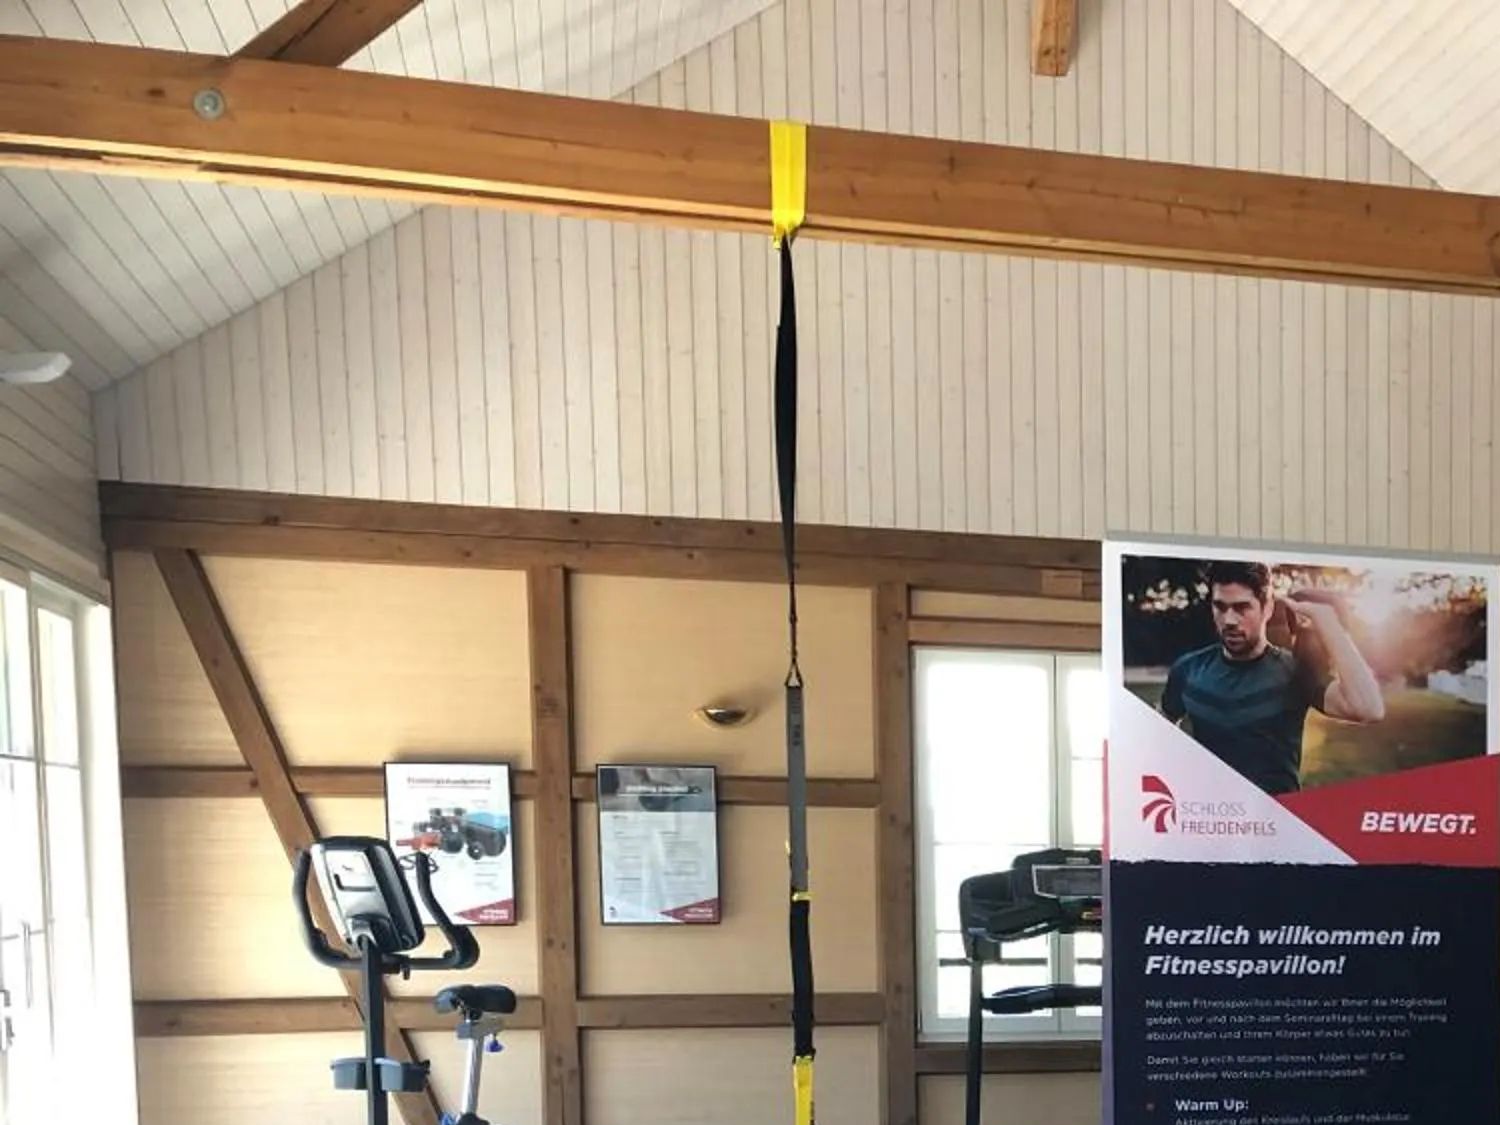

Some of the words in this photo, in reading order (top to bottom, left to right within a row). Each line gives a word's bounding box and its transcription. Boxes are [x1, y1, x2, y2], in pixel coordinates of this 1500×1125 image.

[1181, 801, 1247, 817] SCHLOSS
[1181, 820, 1277, 836] FREUDENFELS
[1361, 811, 1477, 835] BEWEGT.
[1144, 925, 1249, 946] Herzlich
[1258, 925, 1403, 946] willkommen
[1411, 926, 1441, 946] im
[1144, 955, 1346, 980] Fitnesspavillon!
[1166, 998, 1190, 1008] dem
[1186, 1015, 1203, 1024] vor
[1205, 1014, 1226, 1024] und
[1229, 1014, 1255, 1023] nach
[1219, 1030, 1241, 1039] und
[1175, 1100, 1219, 1111] Warm
[1223, 1099, 1249, 1113] Up:
